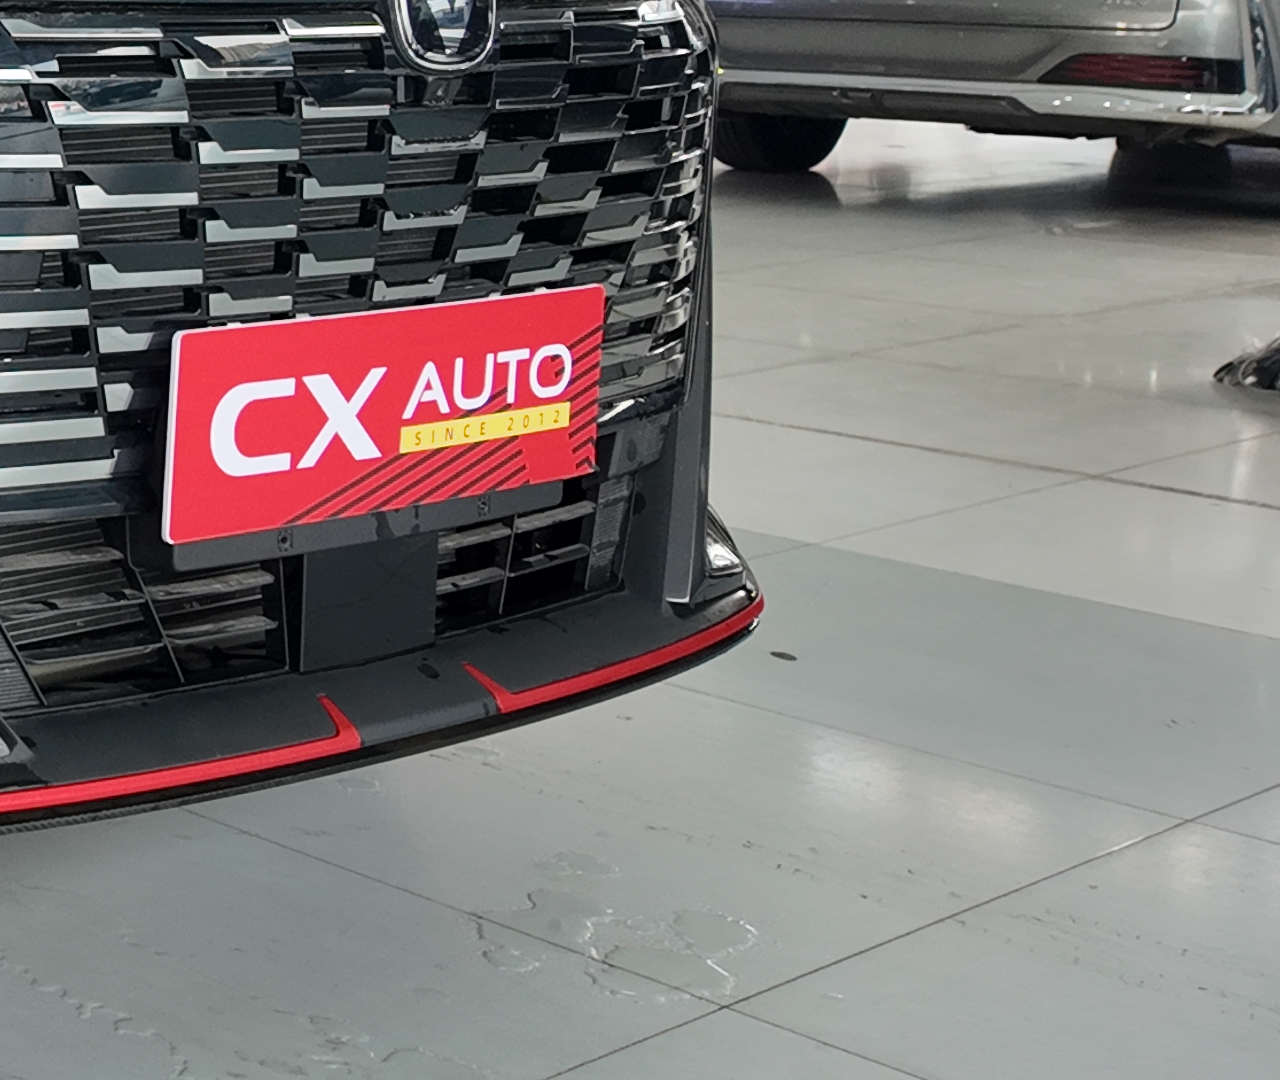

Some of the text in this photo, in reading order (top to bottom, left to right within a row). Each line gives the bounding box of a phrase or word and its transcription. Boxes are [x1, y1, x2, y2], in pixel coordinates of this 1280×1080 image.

[210, 343, 573, 478] CX AUTO
[414, 409, 562, 447] SINCE 2012
